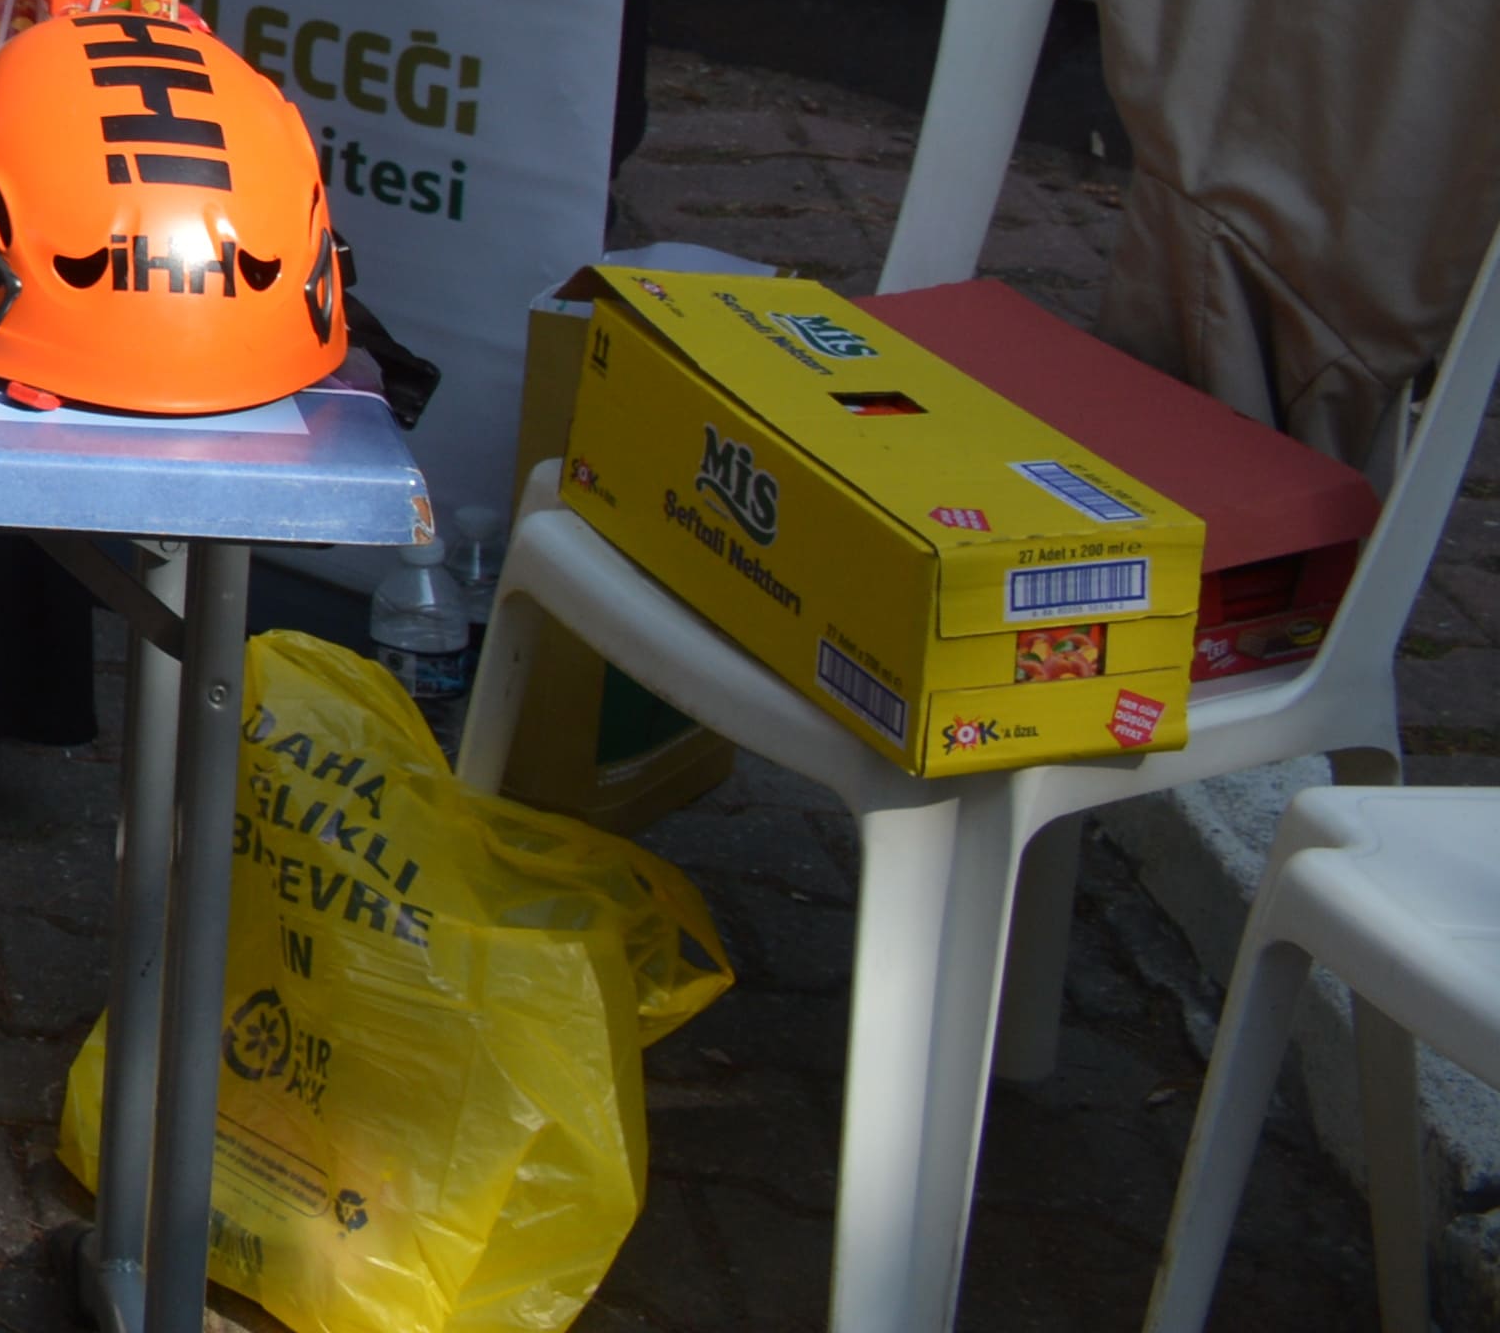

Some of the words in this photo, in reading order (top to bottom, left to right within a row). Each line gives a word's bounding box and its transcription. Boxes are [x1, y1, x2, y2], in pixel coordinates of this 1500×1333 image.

[1018, 549, 1034, 565] 27
[1038, 545, 1067, 563] Adet
[1070, 549, 1077, 559] x
[1080, 543, 1104, 559] 200
[1107, 541, 1124, 555] ml
[941, 719, 1000, 755] ŞOK
